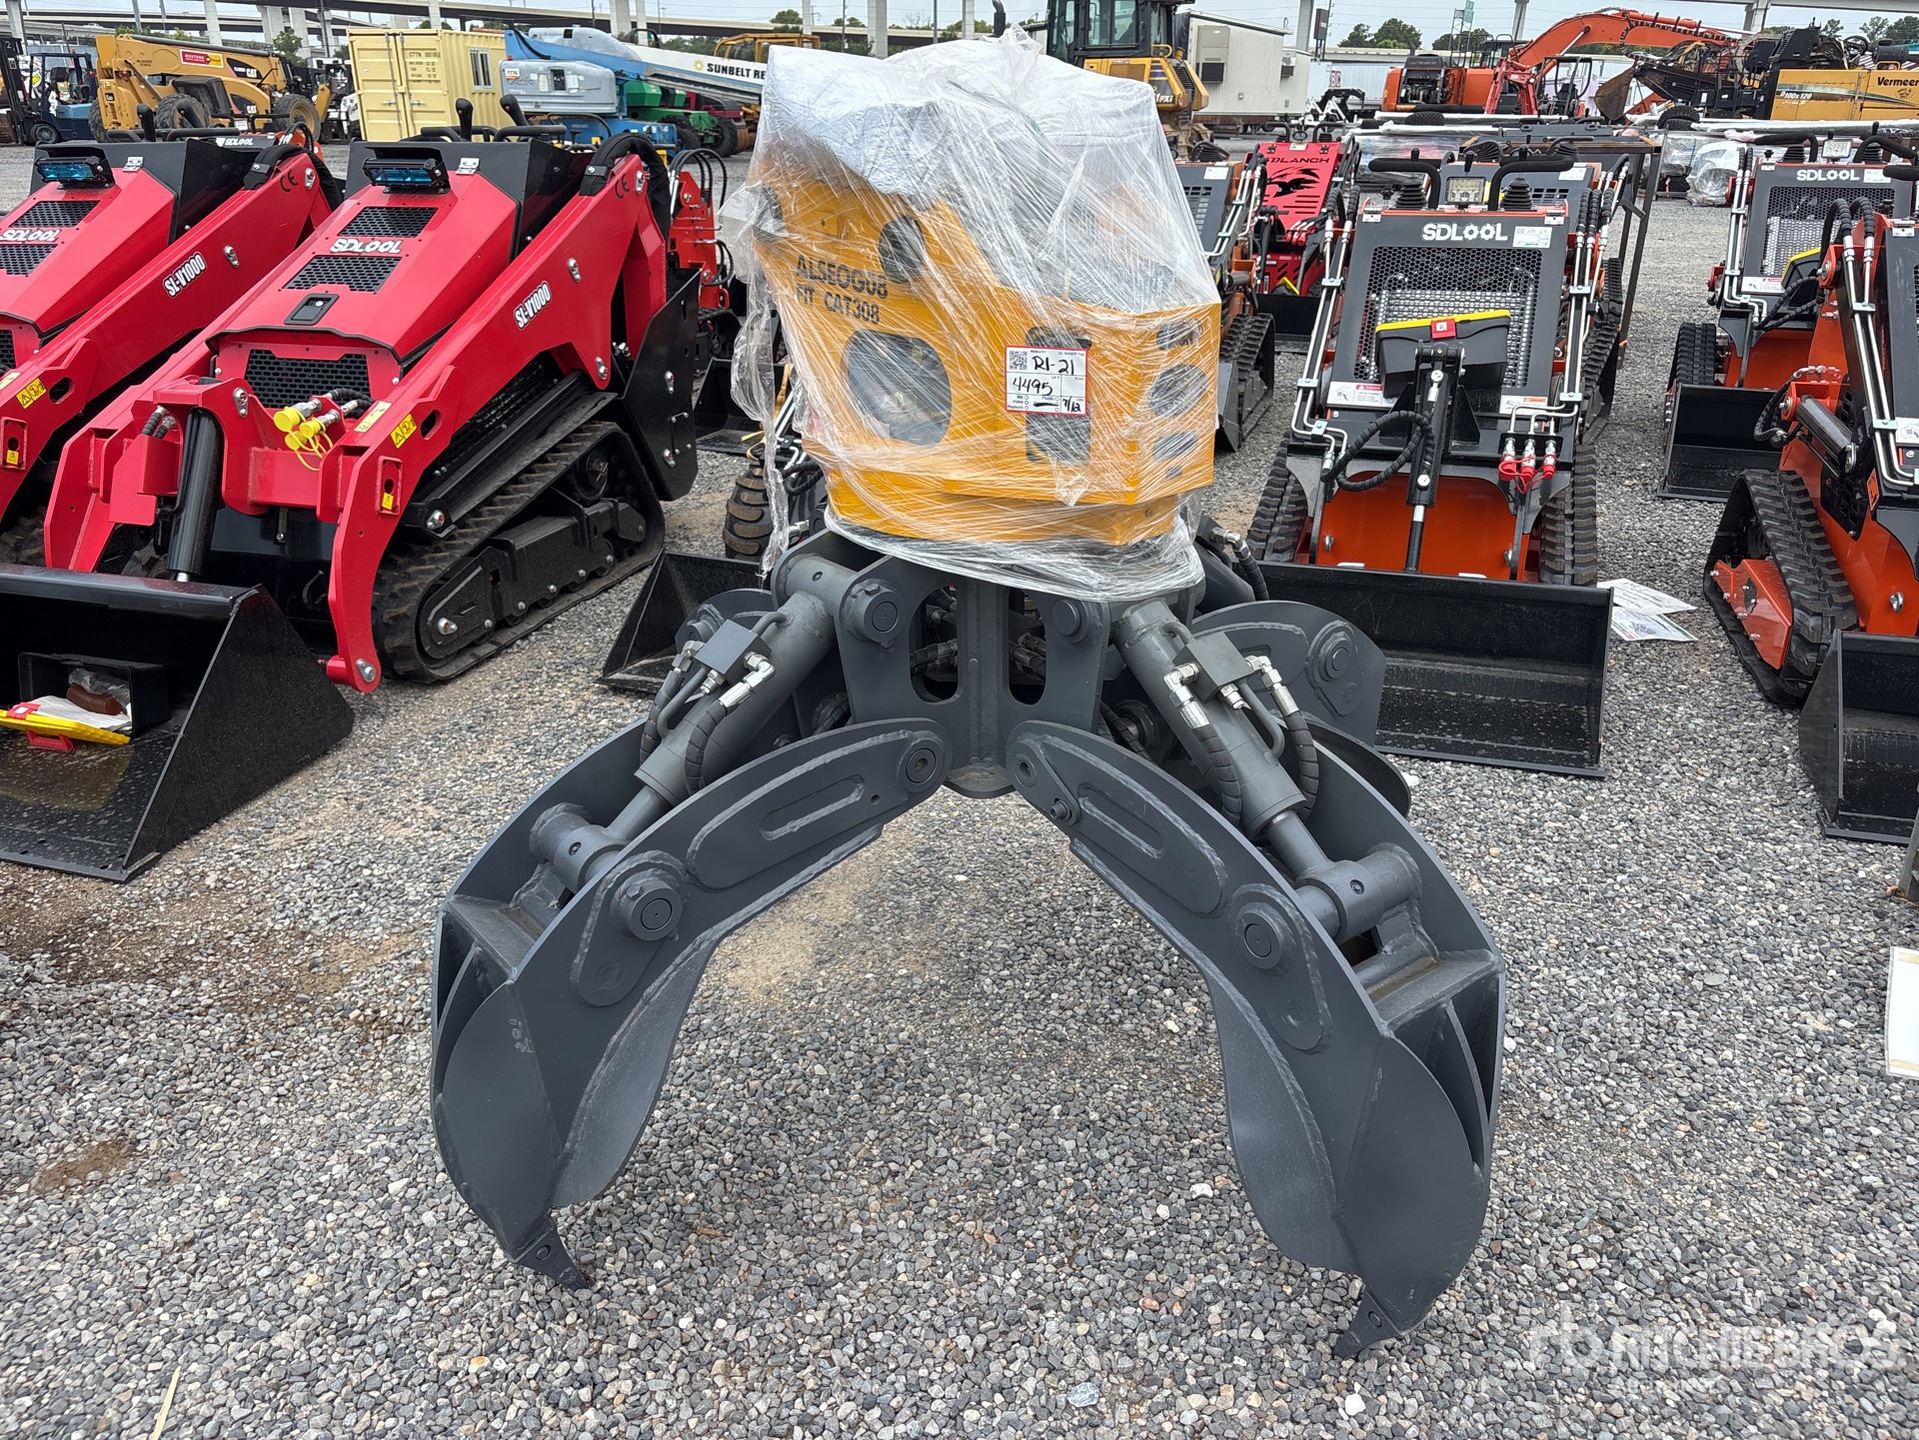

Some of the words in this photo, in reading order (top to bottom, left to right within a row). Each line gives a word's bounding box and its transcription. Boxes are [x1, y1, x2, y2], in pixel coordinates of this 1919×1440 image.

[706, 63, 752, 78] SUNBELT
[1877, 76, 1919, 86] Vermeer
[1154, 93, 1174, 103] 1PXi
[224, 137, 254, 146] SDLOOL
[1796, 169, 1860, 182] SDLOOL
[0, 229, 61, 242] SDLOOL
[1422, 222, 1509, 241] SDLOOL
[329, 238, 403, 254] SDLOOL
[163, 253, 207, 297] SL-V1000
[513, 282, 551, 329] SL-V1000
[824, 291, 880, 325] CAT308
[1012, 376, 1053, 396] 4495
